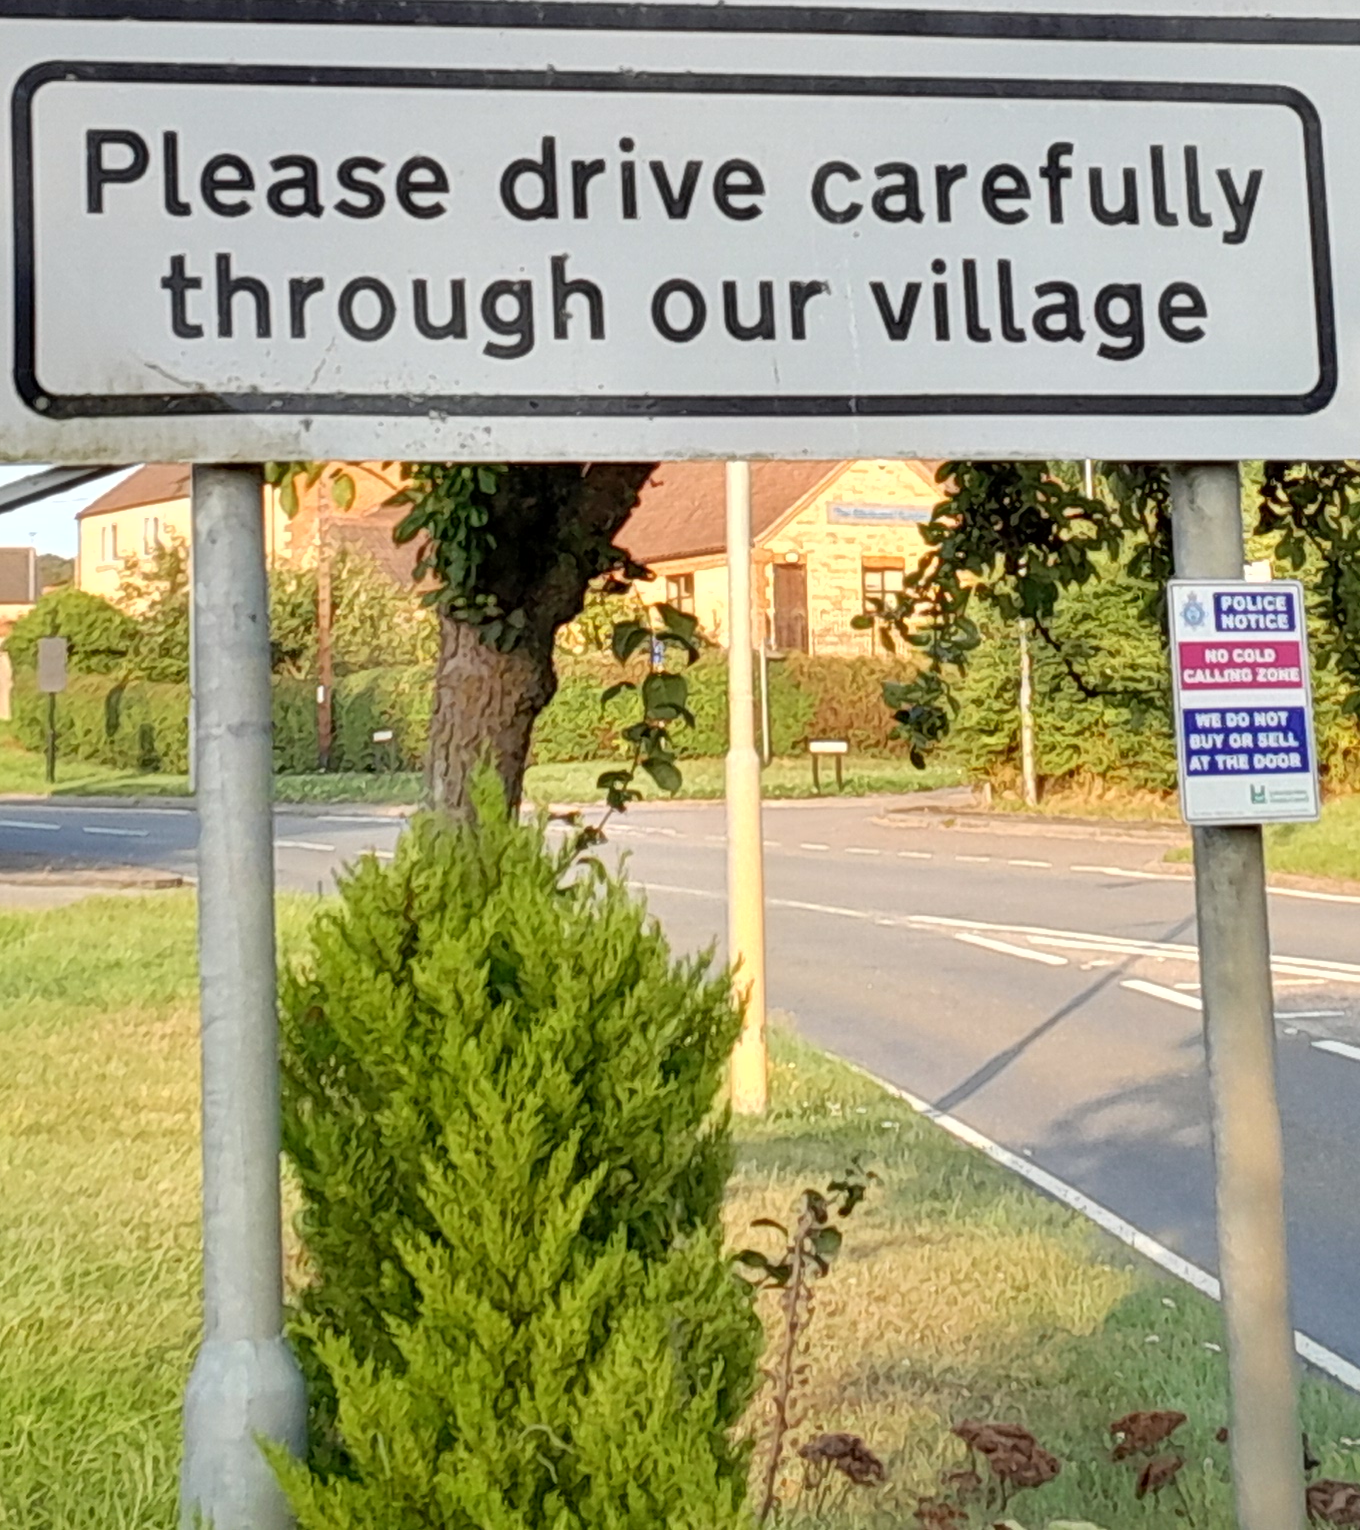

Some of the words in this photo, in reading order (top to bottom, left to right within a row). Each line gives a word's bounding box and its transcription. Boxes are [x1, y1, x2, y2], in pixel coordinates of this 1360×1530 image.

[86, 129, 450, 220] Please
[499, 136, 765, 221] drive
[811, 142, 1263, 245] carefully
[161, 252, 605, 360] through
[651, 277, 829, 343] our
[869, 258, 1208, 362] village
[1221, 595, 1287, 611] POLICE
[1221, 613, 1289, 629] NOTICE
[1205, 648, 1229, 663] NO
[1232, 648, 1276, 663] COLD
[1183, 668, 1253, 683] CALLING
[1255, 667, 1300, 682] ZONE
[1195, 712, 1222, 728] WE
[1226, 712, 1250, 728] DO
[1254, 711, 1288, 727] NOT
[1189, 733, 1225, 749] BUY
[1229, 732, 1253, 748] OR
[1257, 731, 1299, 748] SELL
[1189, 755, 1211, 771] AT
[1215, 754, 1249, 770] THE
[1253, 752, 1302, 769] DOOR
